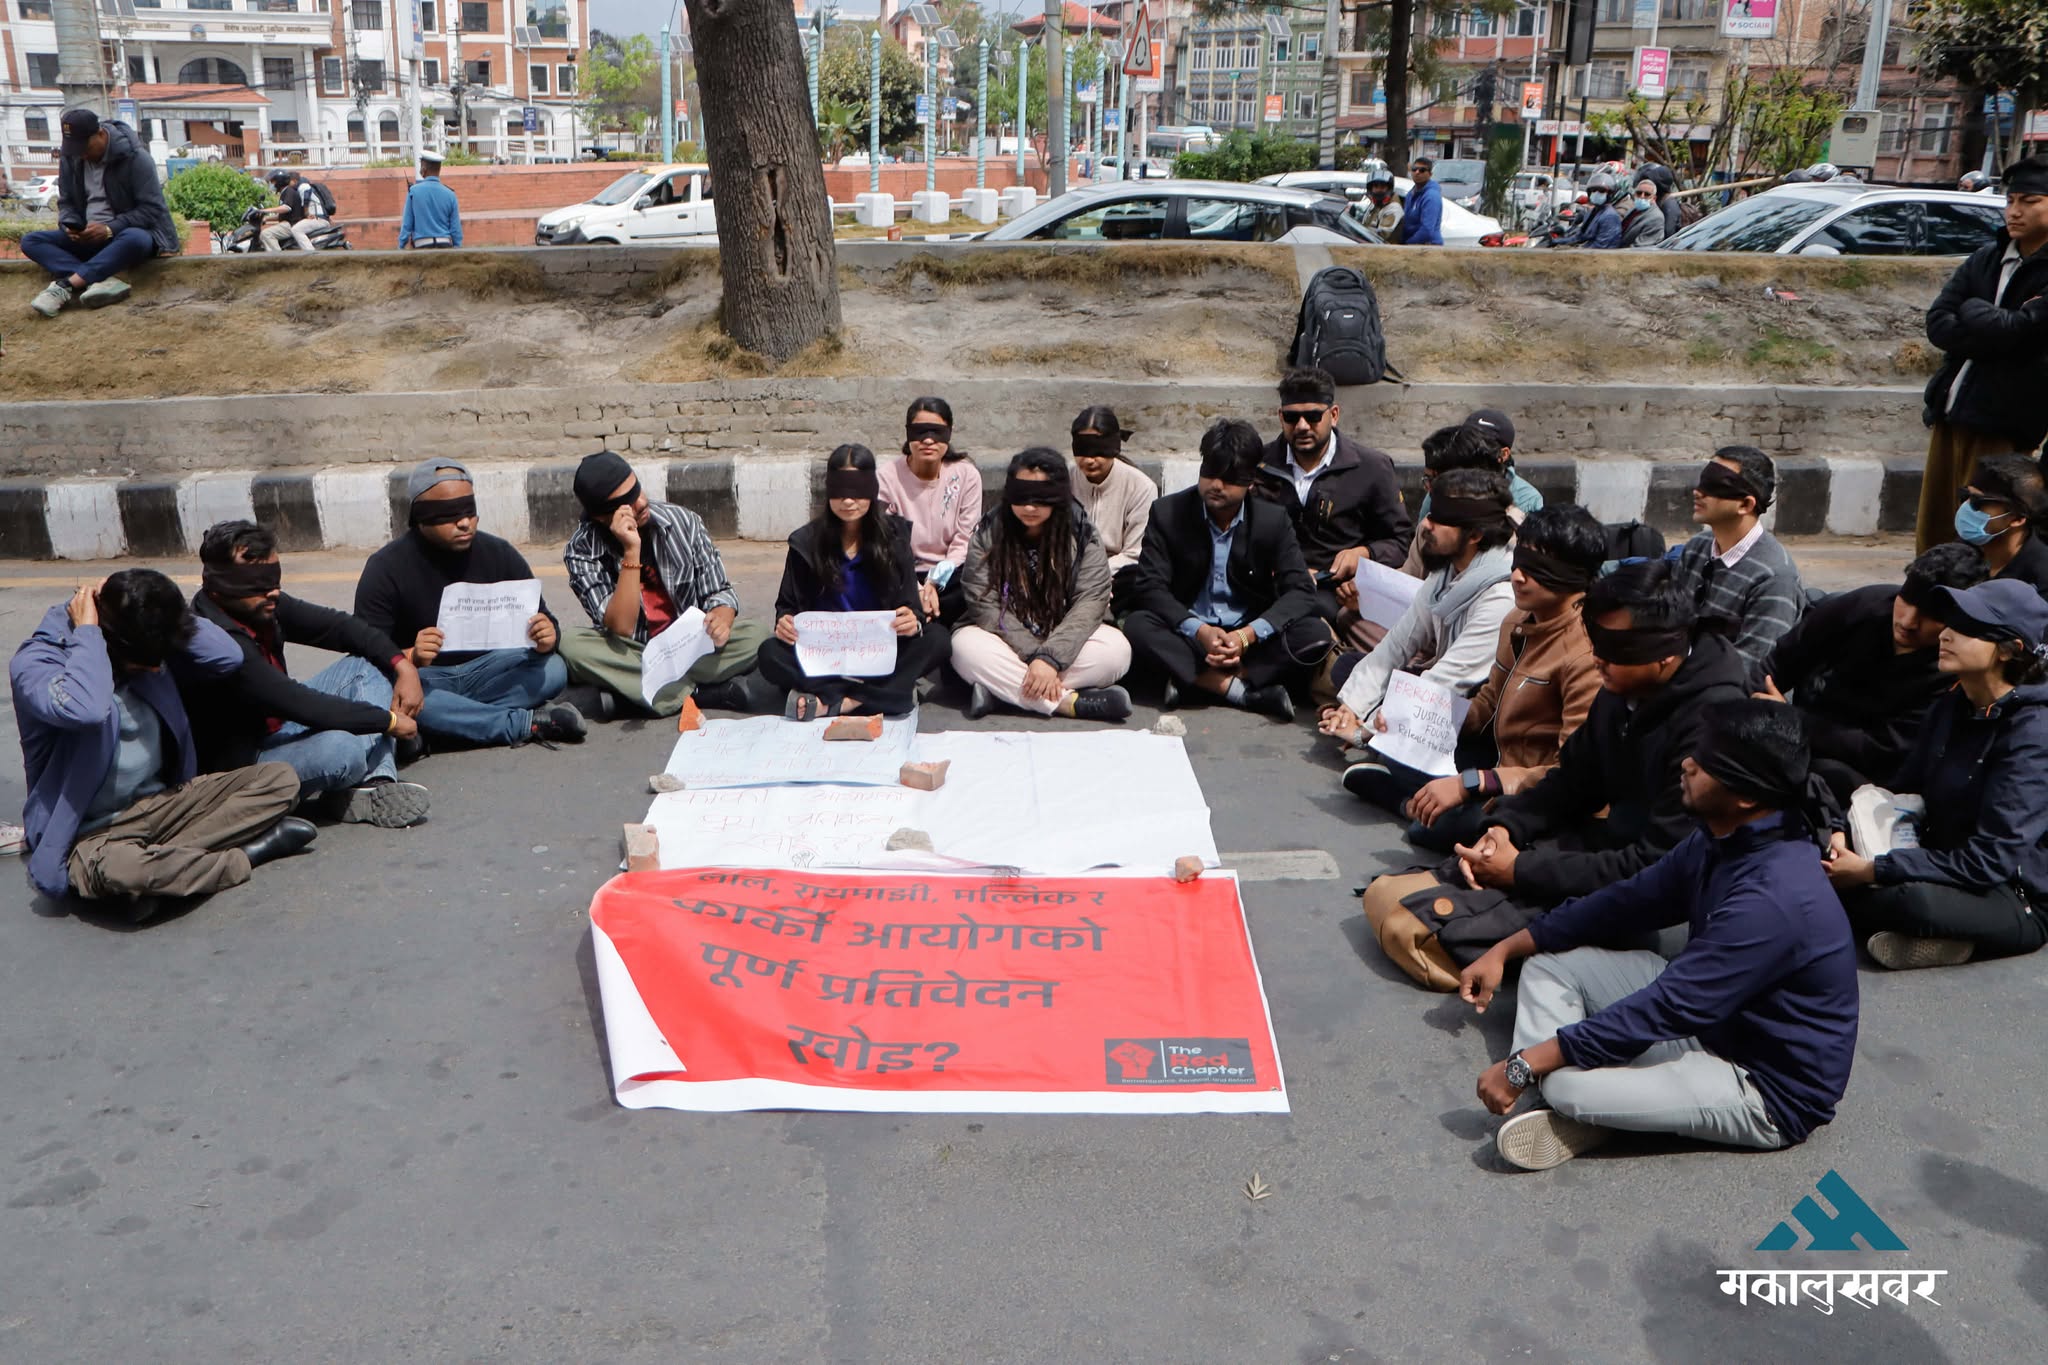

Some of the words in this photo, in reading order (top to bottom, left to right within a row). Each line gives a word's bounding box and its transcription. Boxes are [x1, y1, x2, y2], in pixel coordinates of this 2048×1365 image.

[699, 873, 779, 895] लाल,
[794, 882, 938, 904] रायमाझी,
[952, 884, 1081, 905] मल्लिक
[1088, 891, 1108, 906] र
[672, 896, 836, 944] कार्की
[848, 913, 1109, 951] आयोगको
[701, 942, 808, 989] पूर्ण
[817, 969, 1060, 1008] प्रतिवेदन
[1168, 1046, 1202, 1054] The
[1169, 1052, 1230, 1067] Red
[1171, 1065, 1246, 1076] Chapter
